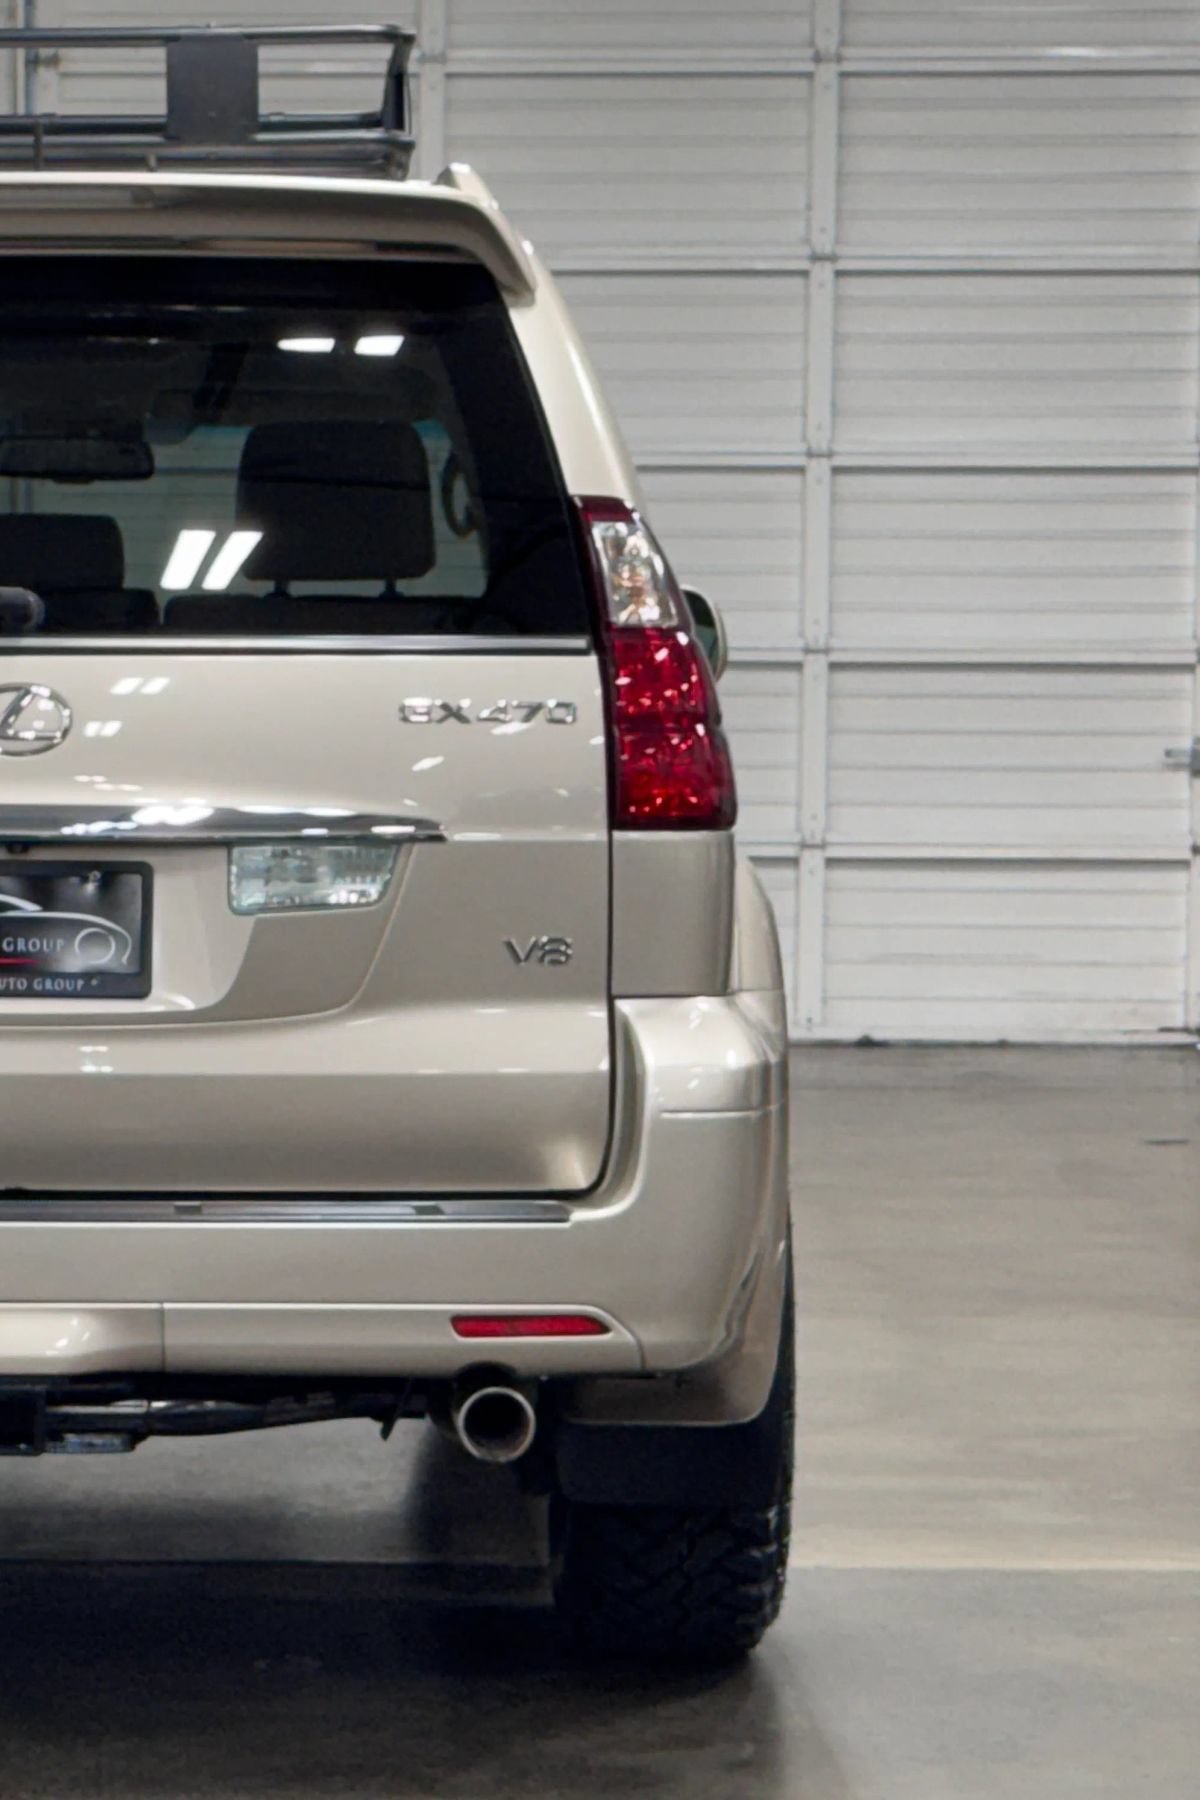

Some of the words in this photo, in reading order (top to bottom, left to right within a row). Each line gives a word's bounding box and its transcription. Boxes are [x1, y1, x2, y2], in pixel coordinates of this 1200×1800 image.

[477, 697, 577, 724] 470
[2, 937, 65, 952] GROUP
[503, 936, 573, 966] V8
[32, 978, 84, 991] GROUP
